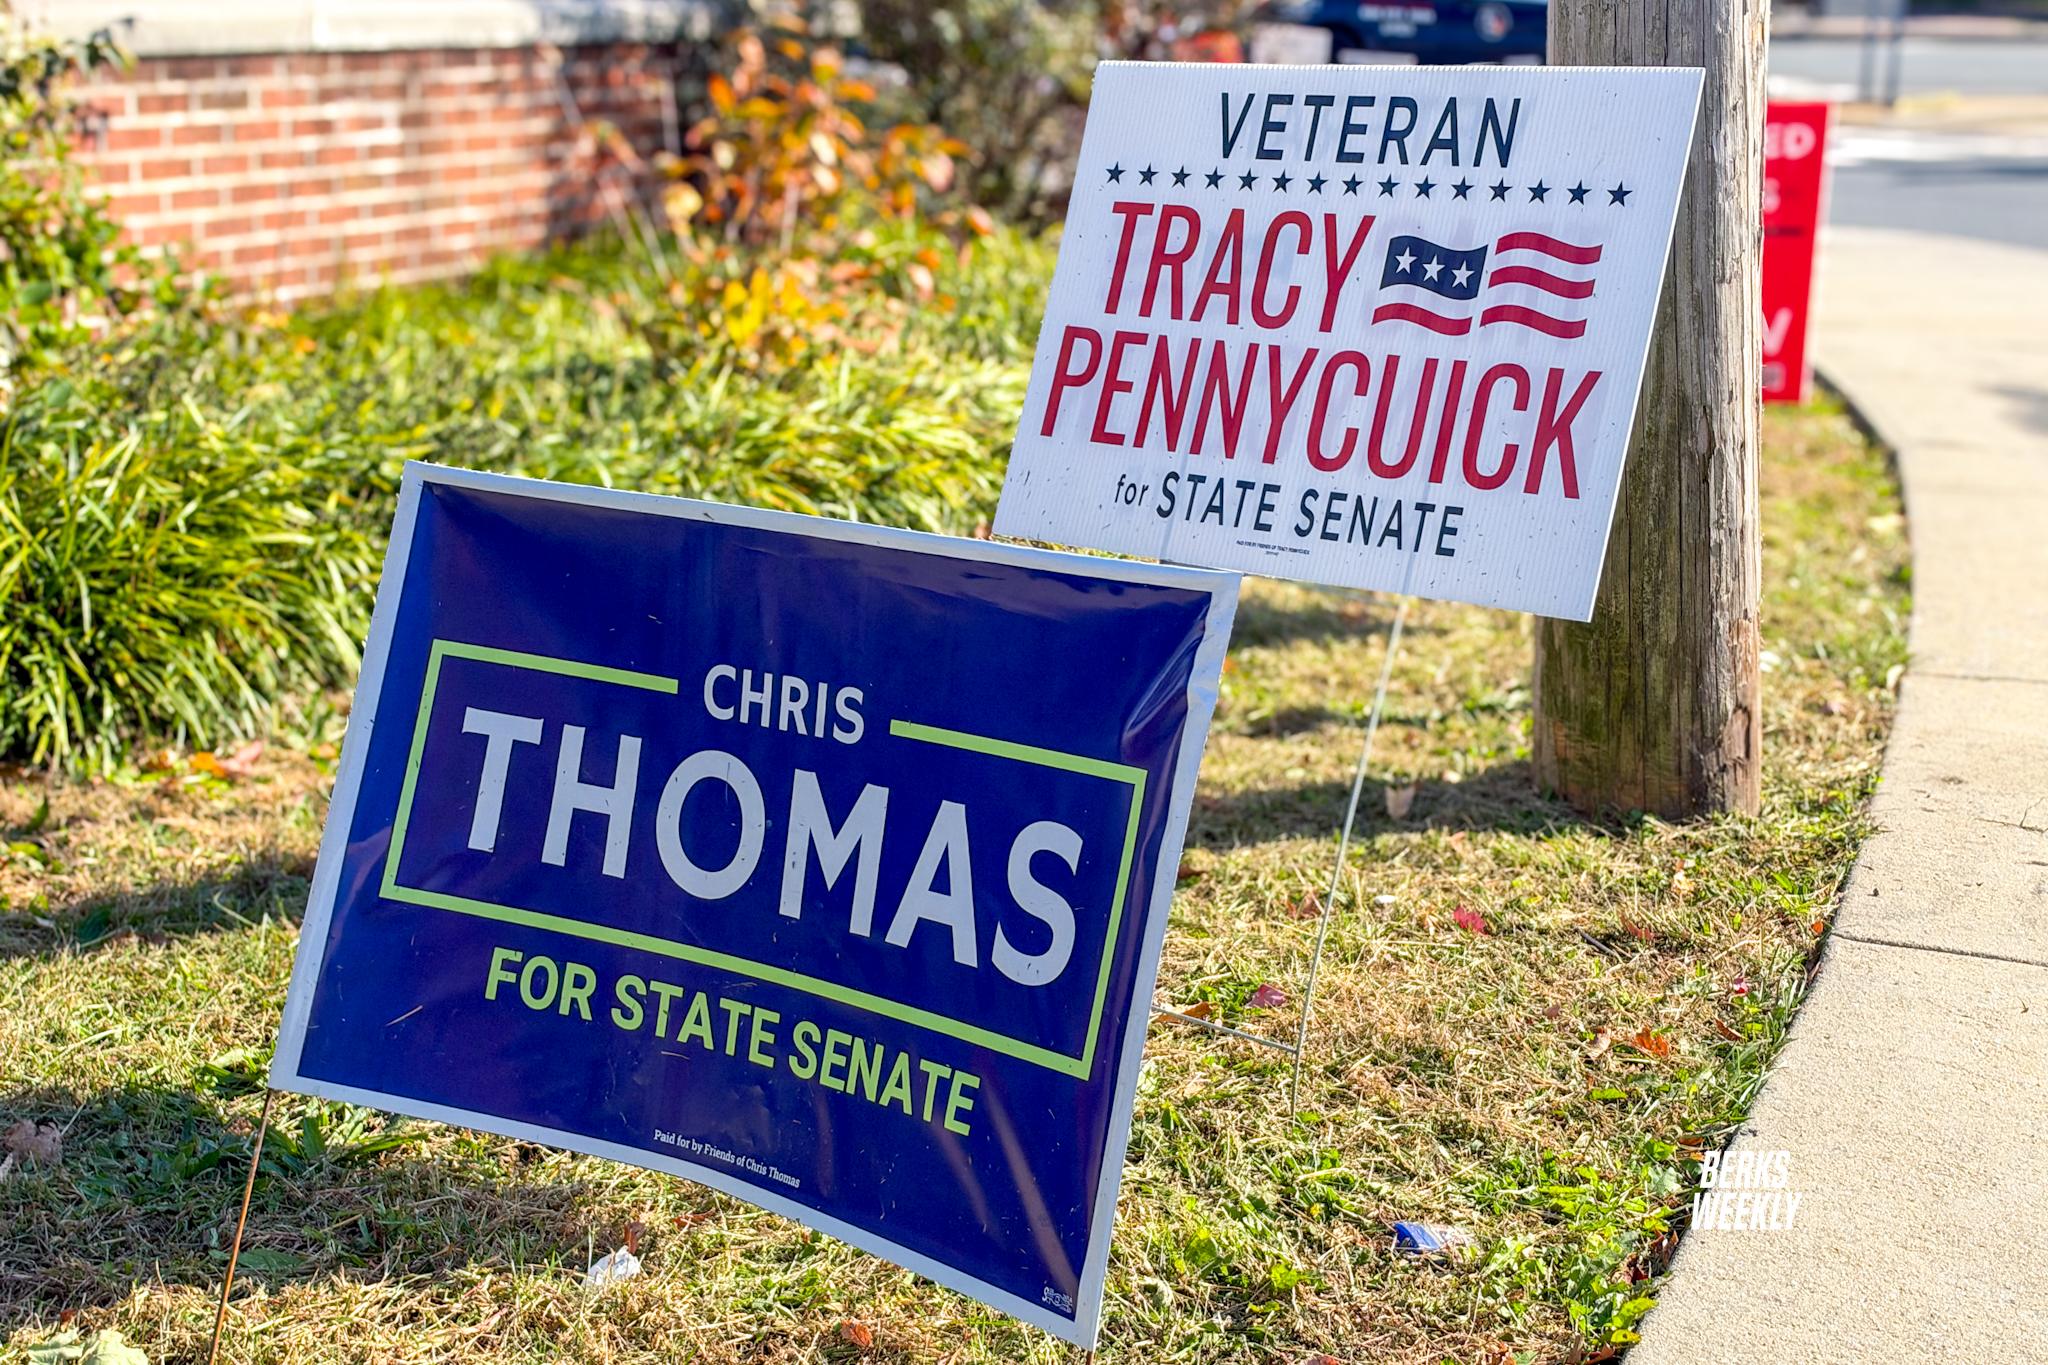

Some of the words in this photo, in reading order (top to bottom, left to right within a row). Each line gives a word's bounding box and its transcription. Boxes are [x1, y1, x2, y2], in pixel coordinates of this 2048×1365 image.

[1220, 92, 1521, 168] VETERAN
[1104, 201, 1376, 332] TRACY
[1040, 325, 1603, 499] PENNYCUICK
[1115, 474, 1149, 505] for
[1156, 471, 1281, 532] STATE
[1294, 488, 1464, 557] SENATE
[704, 664, 864, 744] CHRIS
[462, 706, 1084, 987] THOMAS
[485, 947, 597, 1021] FOR
[610, 974, 781, 1068] STATE
[788, 1021, 981, 1136] SENATE
[653, 1129, 675, 1144] Paid
[676, 1135, 690, 1149] for
[691, 1139, 703, 1154] by
[704, 1143, 735, 1164] Friends
[736, 1156, 745, 1167] of
[745, 1157, 767, 1175] Chris
[768, 1166, 800, 1188] Thomas
